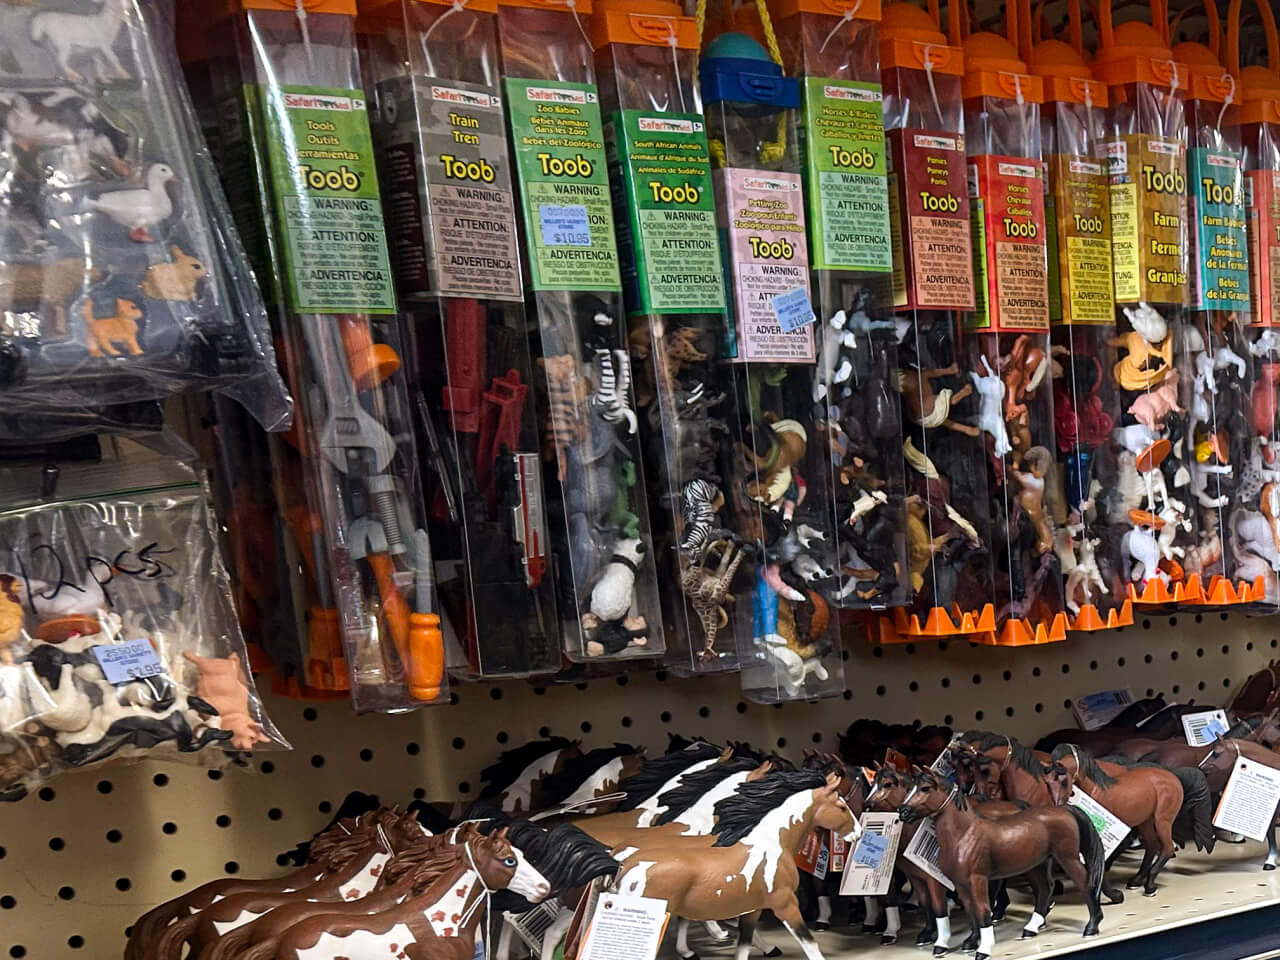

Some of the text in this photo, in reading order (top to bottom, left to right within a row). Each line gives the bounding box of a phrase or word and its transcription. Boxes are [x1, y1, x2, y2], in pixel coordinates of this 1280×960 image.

[432, 87, 461, 101] Safari
[528, 89, 556, 101] Safari
[537, 104, 581, 115] Zoo Babies
[306, 120, 335, 131] Tools
[448, 113, 479, 128] Train
[640, 119, 664, 130] Safari
[535, 126, 553, 134] dans
[307, 134, 340, 145] Outils
[452, 130, 480, 145] Tren
[634, 140, 702, 152] South African Animals
[296, 149, 360, 160] erramientas
[829, 145, 875, 169] Toob
[440, 155, 495, 184] Toob
[537, 153, 593, 178] Toob
[295, 164, 361, 191] Toob
[841, 174, 884, 185] WARNING:
[1143, 165, 1186, 194] Toob
[554, 184, 604, 196] WARNING:
[649, 181, 699, 204] Toob
[1008, 183, 1030, 193] Horses
[456, 188, 505, 203] WARNING:
[314, 199, 373, 211] WARNING:
[837, 200, 887, 211] ATTENTION:
[919, 191, 959, 213] Toob
[664, 211, 709, 222] WARNING:
[1152, 210, 1180, 228] Farm
[1203, 214, 1223, 225] Farm
[453, 218, 510, 232] ATTENTION:
[1003, 217, 1038, 239] Toob
[1073, 213, 1103, 234] Toob
[311, 230, 379, 243] ATTENTION:
[834, 233, 890, 244] ADVERTENCIA:
[662, 239, 714, 249] ATTENTION:
[749, 236, 794, 260] Toob
[551, 250, 616, 261] ADVERTENCIA:
[450, 255, 516, 270] ADVERTENCIA:
[1206, 258, 1217, 269] de
[1218, 259, 1227, 269] la
[310, 269, 388, 282] ADVERTENCIA:
[761, 266, 802, 276] WARNING:
[661, 274, 720, 284] ADVERTENCIA:
[1206, 290, 1218, 300] de
[1219, 290, 1228, 299] la
